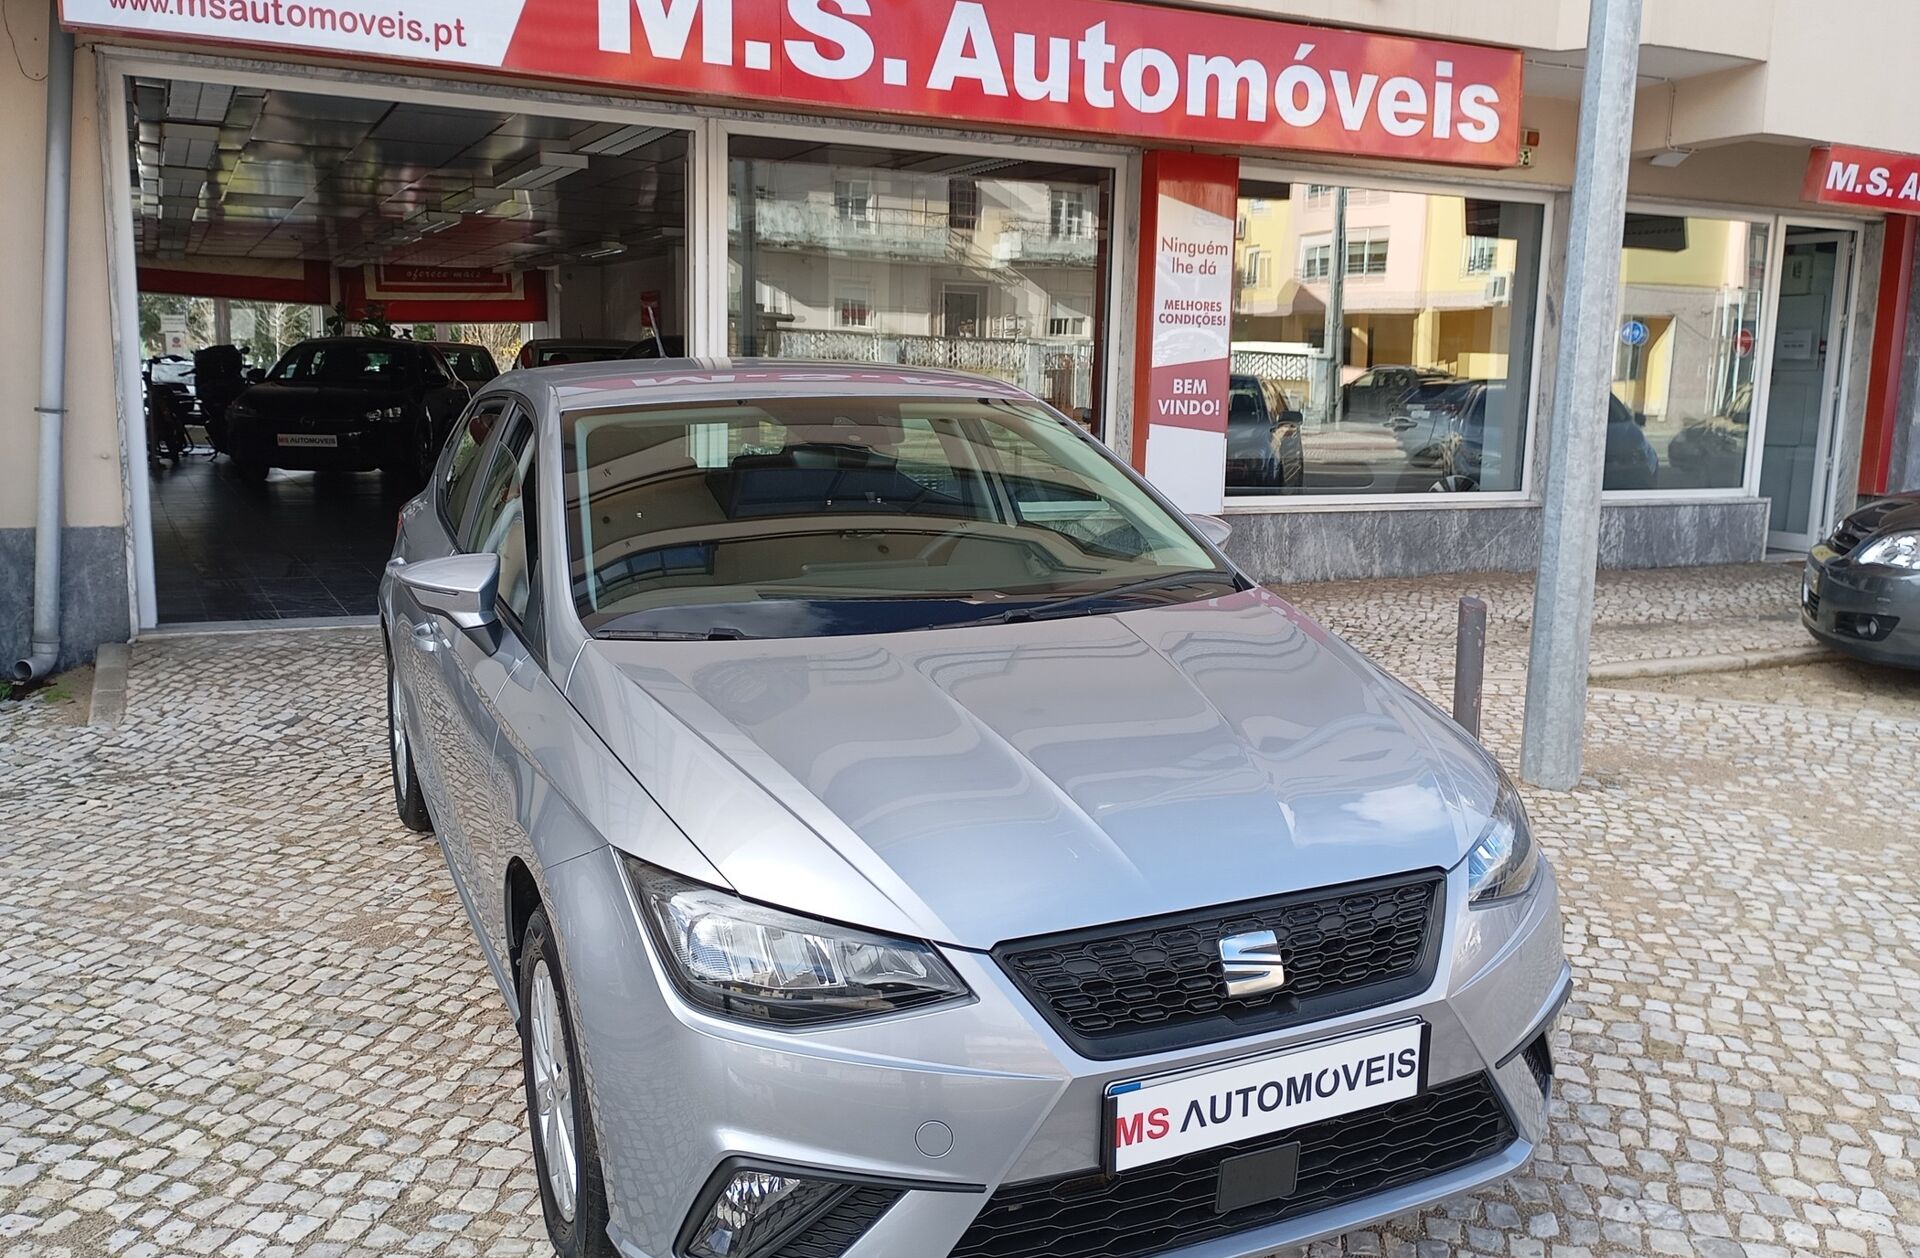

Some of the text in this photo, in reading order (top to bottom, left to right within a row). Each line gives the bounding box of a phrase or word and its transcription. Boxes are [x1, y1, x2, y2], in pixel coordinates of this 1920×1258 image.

[599, 0, 1500, 144] M.S. Automóveis
[1825, 160, 1920, 202] M.S. A
[1161, 237, 1228, 257] Ninguém
[1172, 257, 1217, 276] lhe dá
[1164, 299, 1222, 312] MELHORES
[1159, 313, 1226, 328] CONDIÇÕES!
[1173, 379, 1208, 394] BEM
[1158, 399, 1220, 415] VINDO!
[1116, 1107, 1170, 1148] MS
